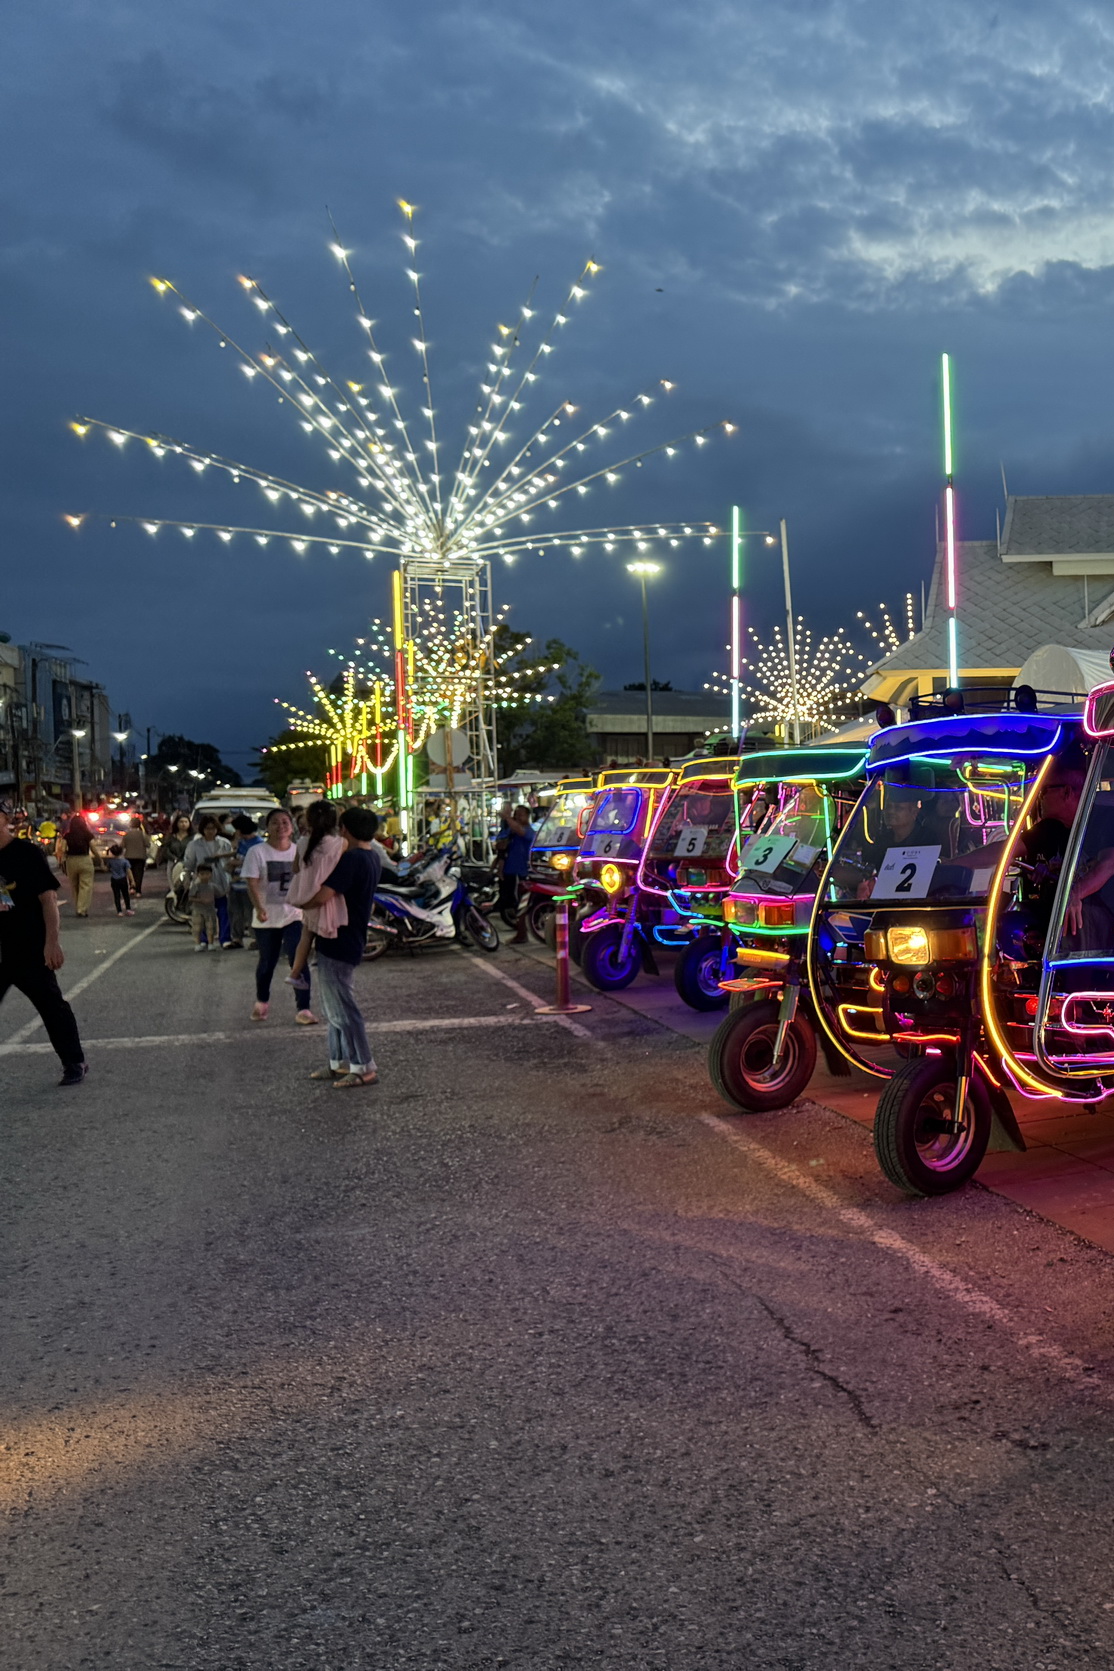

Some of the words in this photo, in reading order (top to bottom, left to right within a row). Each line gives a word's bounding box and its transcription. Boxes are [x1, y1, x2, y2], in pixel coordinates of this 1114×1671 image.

[603, 840, 612, 854] 6
[686, 837, 697, 853] 5
[754, 846, 773, 866] 3
[894, 862, 917, 893] 2
